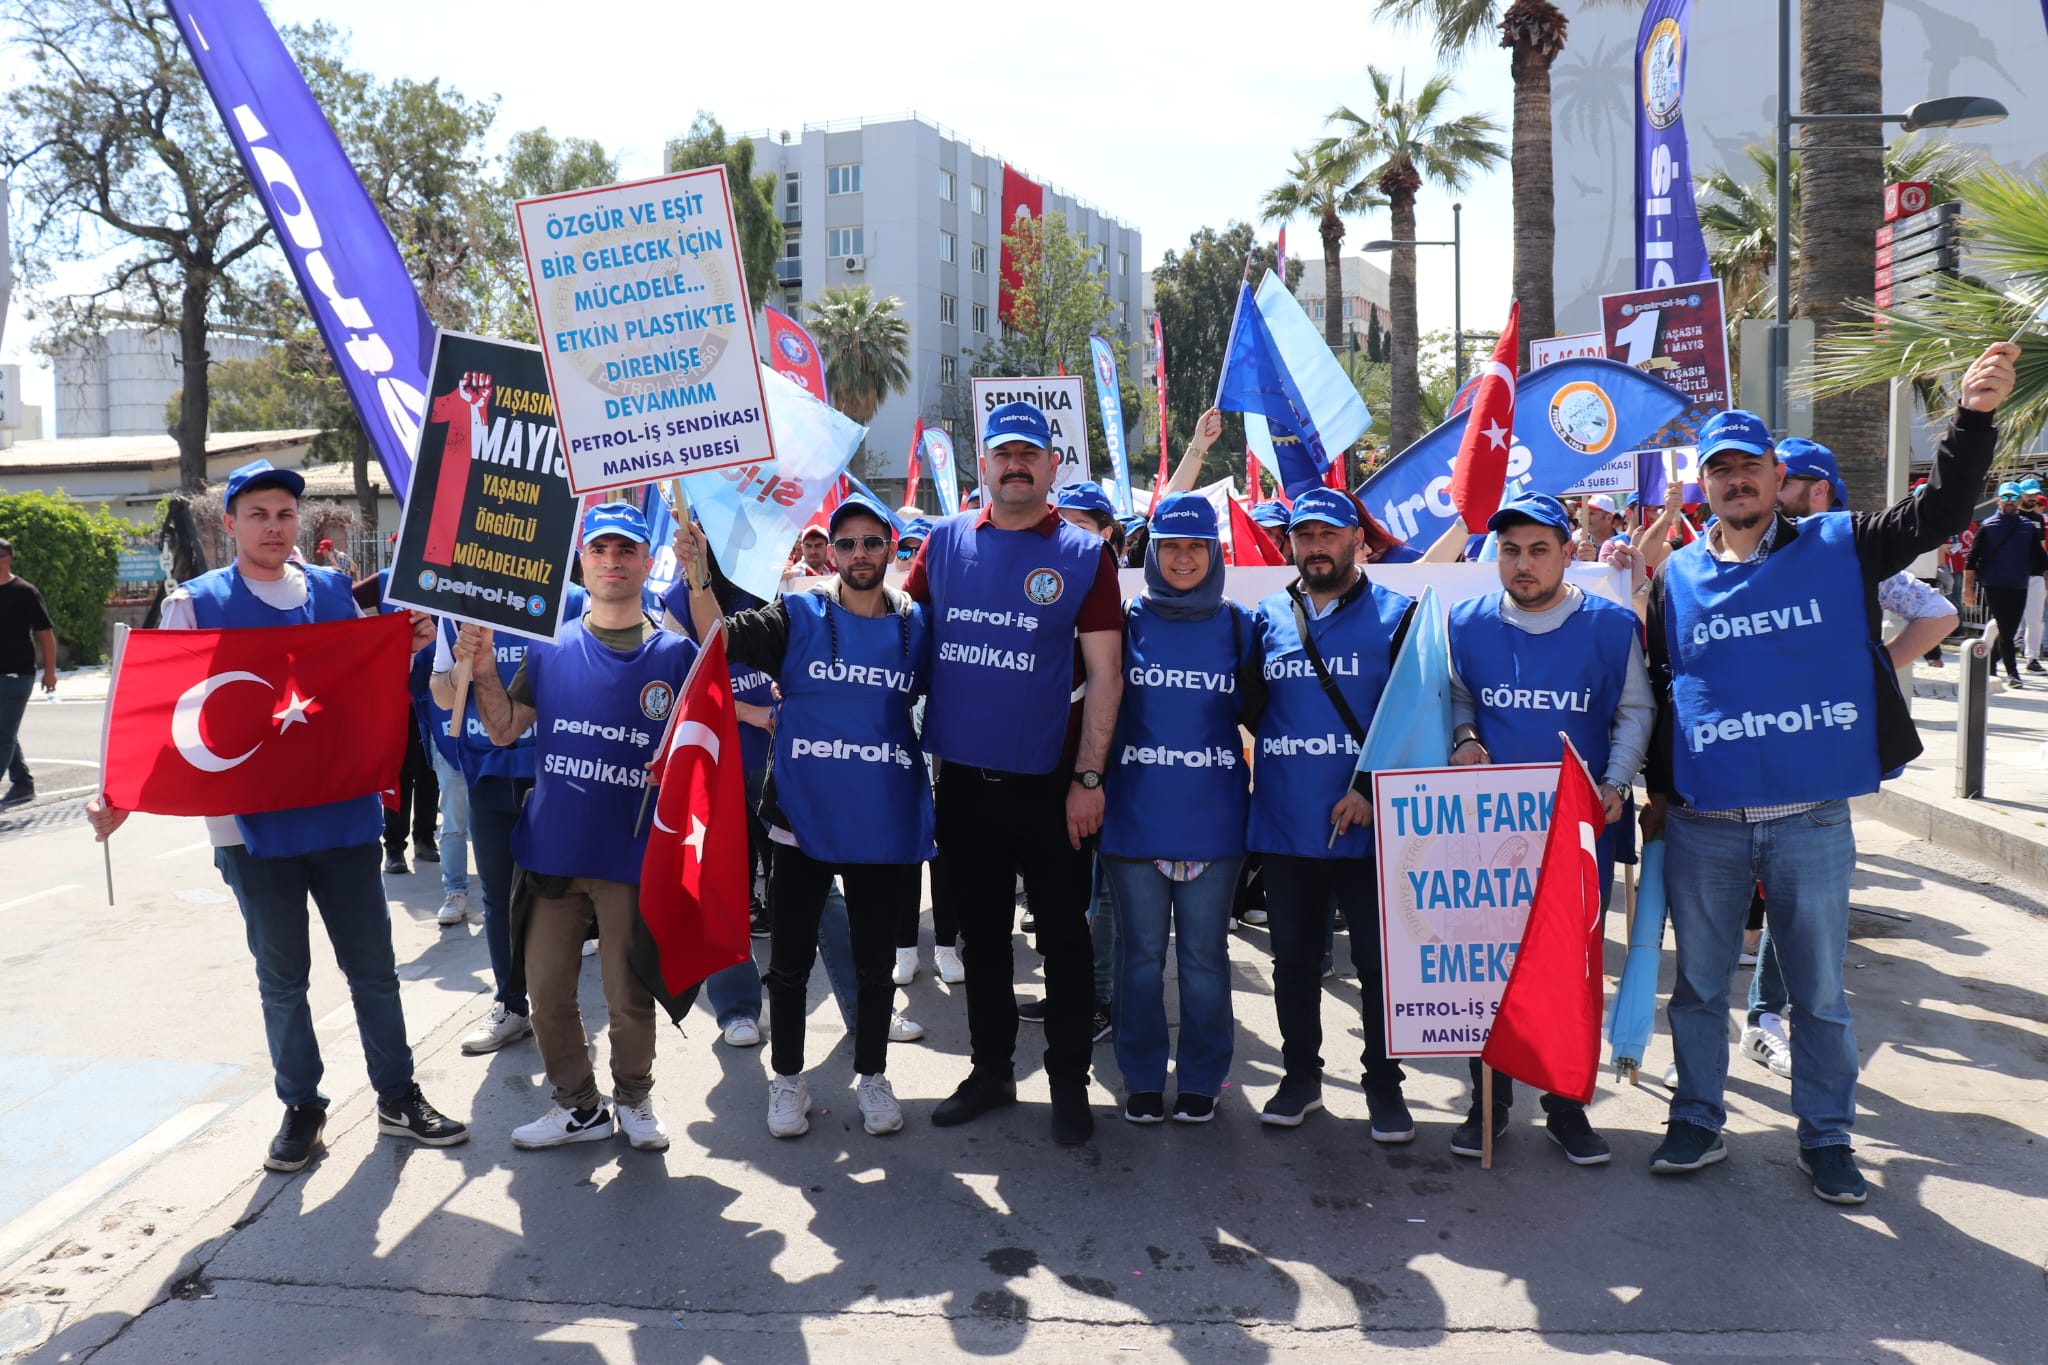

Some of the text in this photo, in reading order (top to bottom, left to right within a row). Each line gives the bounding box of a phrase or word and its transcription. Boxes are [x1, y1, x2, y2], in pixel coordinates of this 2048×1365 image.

[546, 190, 704, 240] ÖZGÜR VE EŞİT
[541, 226, 723, 280] BİR GELECEK İÇİN
[575, 274, 705, 312] MÜCADELE...
[1634, 297, 1689, 313] petrol-iş
[556, 320, 619, 353] ETKİN
[1672, 340, 1704, 353] MAYIS
[606, 345, 702, 382] DİRENİŞE
[1662, 366, 1705, 381] YAŞASIN
[495, 384, 553, 417] YAŞASIN
[604, 382, 717, 420] DEVAMMM
[571, 407, 760, 454] PETROL-İŞ SENDİKASI
[1000, 414, 1037, 425] petrol-iş
[1708, 424, 1750, 440] petrol-iş
[603, 435, 740, 477] MANİSA ŞUBESİ
[482, 473, 541, 505] YAŞASIN
[475, 506, 537, 543] ÖRGÜTLÜ
[1161, 510, 1199, 521] petrol-iş
[453, 542, 553, 585] MÜCADELEMİZ
[436, 575, 527, 611] petrol-iş
[946, 607, 1040, 632] petrol-iş
[1693, 599, 1823, 645] GÖREVLİ
[939, 642, 1036, 673] SENDİKASI
[808, 657, 915, 694] GÖREVLİ
[1129, 663, 1236, 694] GÖREVLİ
[1481, 683, 1592, 713] GÖREVLİ
[552, 718, 650, 748] petrol-iş
[1692, 701, 1859, 753] petrol-iş
[792, 738, 913, 770] petrol-iş
[1121, 744, 1236, 770] petrol-iş
[544, 753, 648, 789] SENDİKASI
[1391, 784, 1558, 837] TÜM FARK
[1407, 867, 1541, 910] YARATA
[1395, 997, 1485, 1020] PETROL-İŞ
